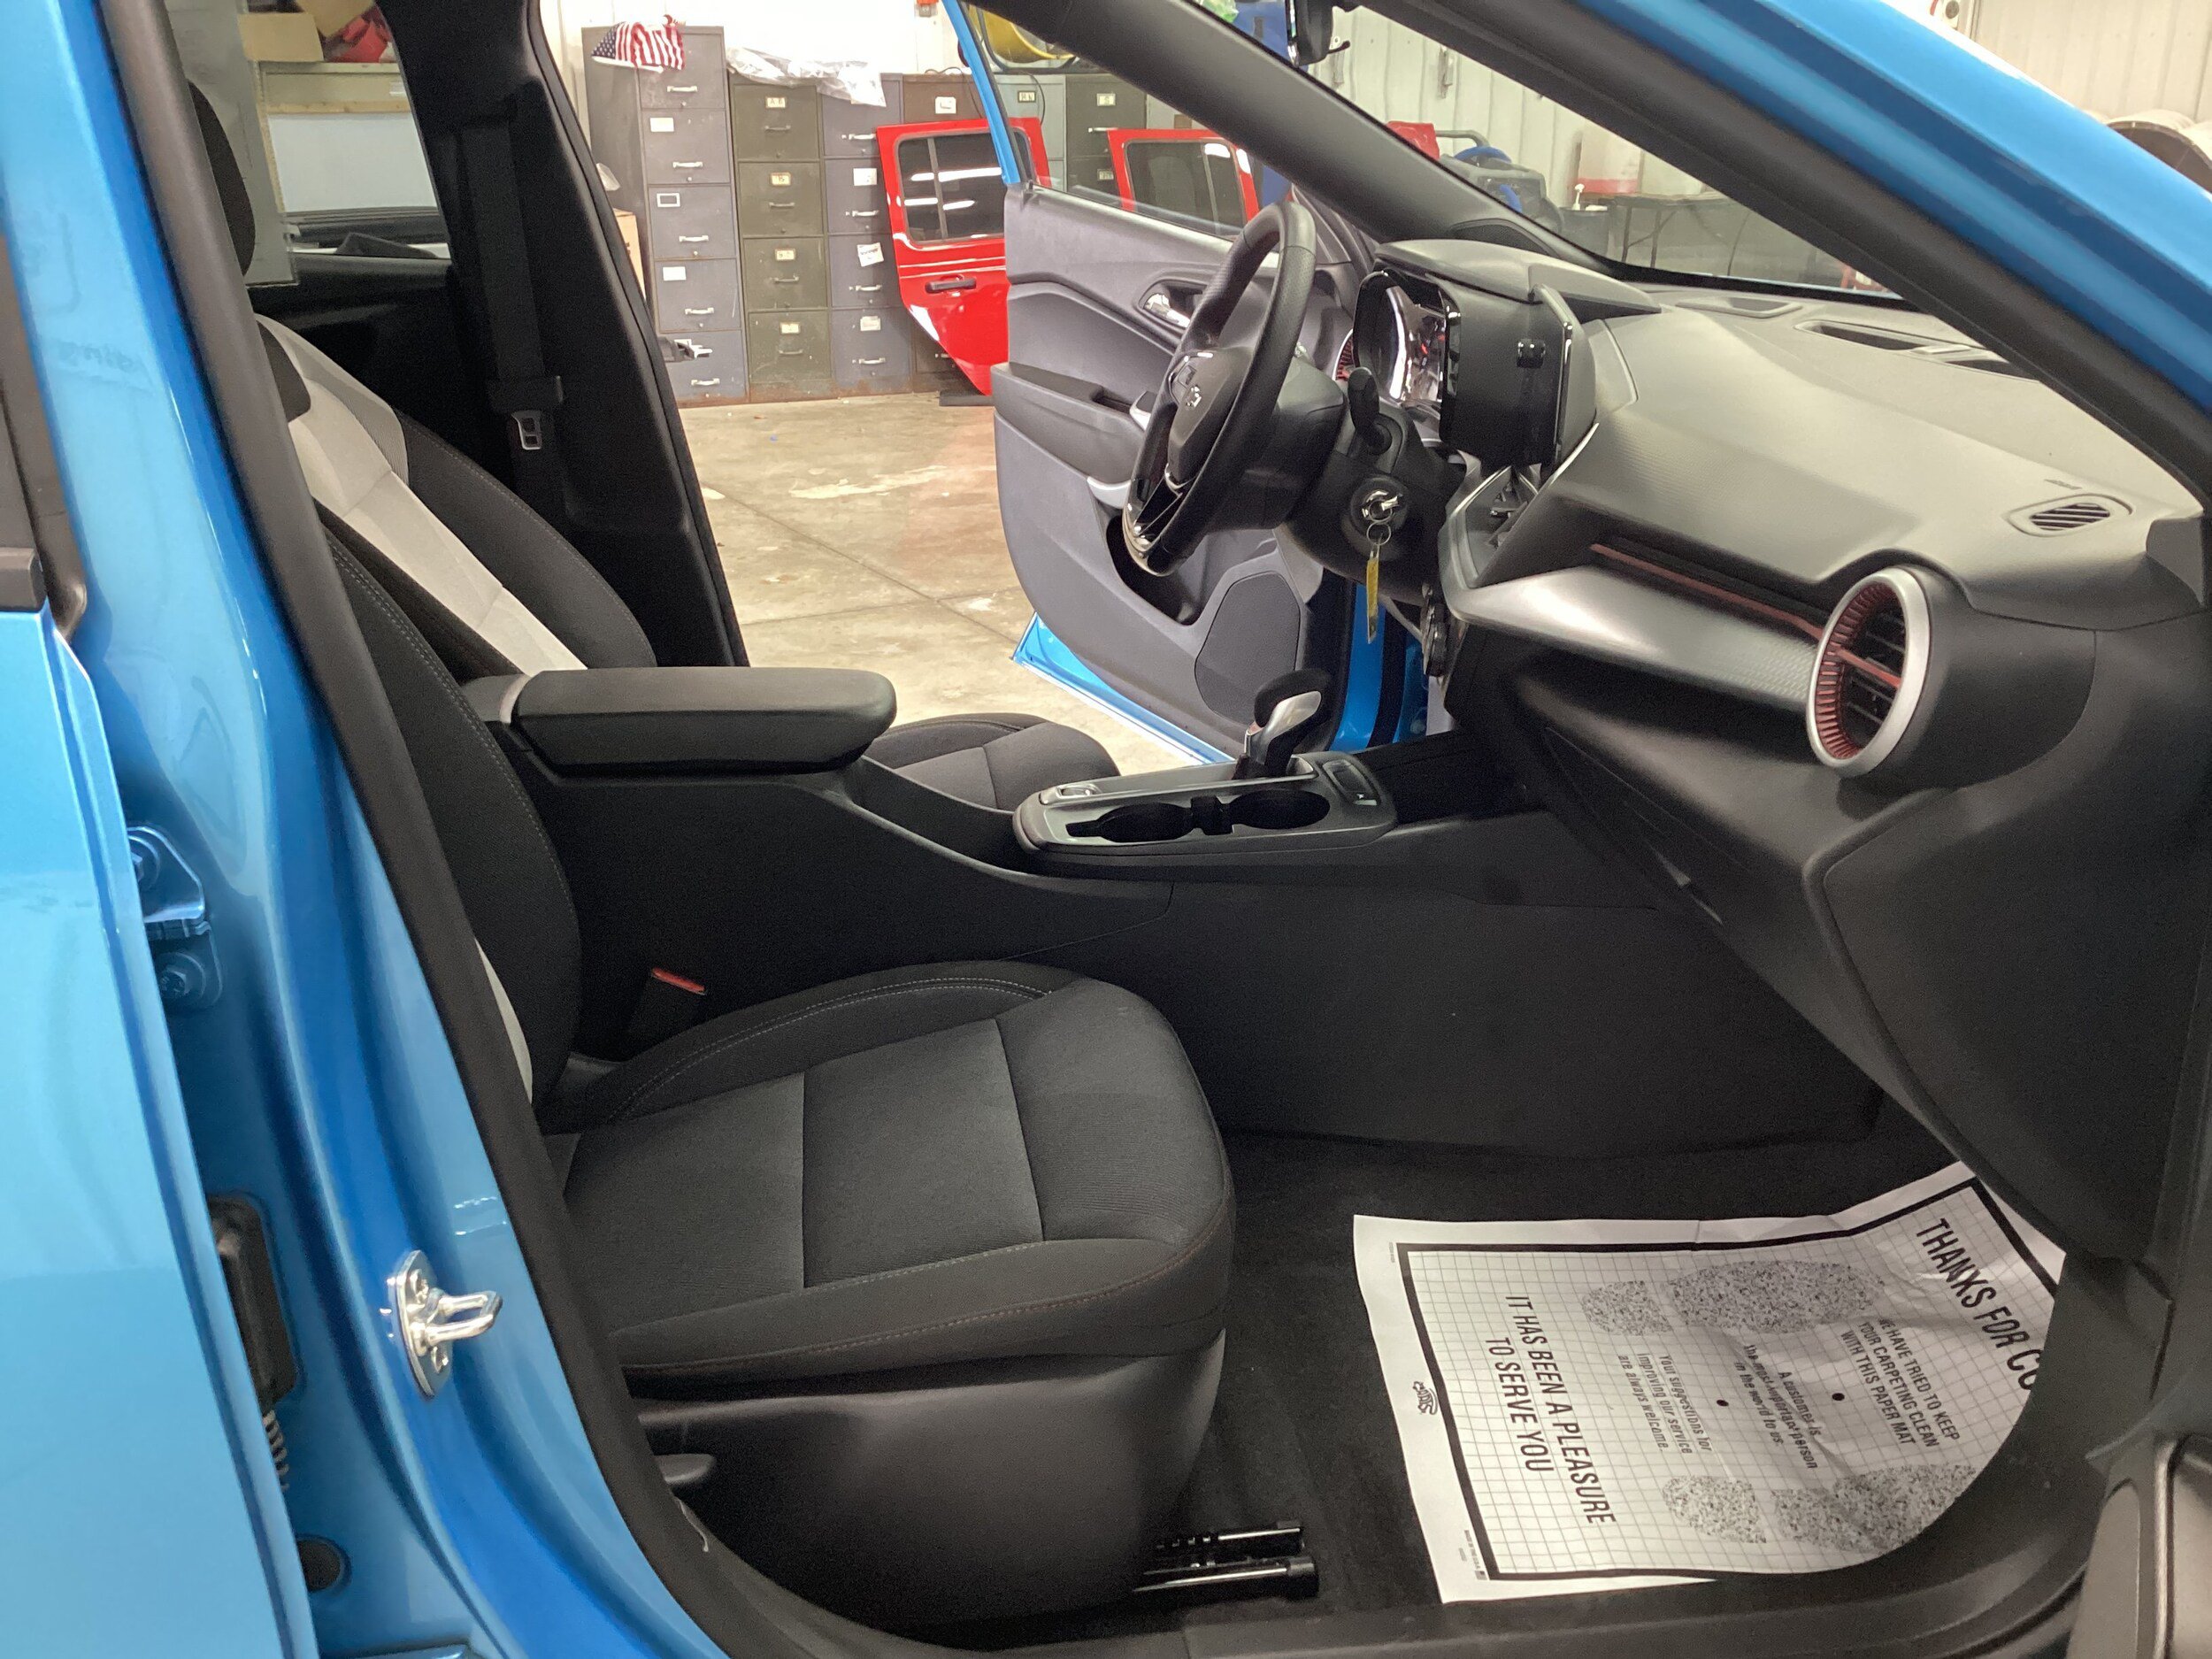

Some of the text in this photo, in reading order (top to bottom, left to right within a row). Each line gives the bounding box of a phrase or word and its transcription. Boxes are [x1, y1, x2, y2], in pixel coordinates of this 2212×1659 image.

[1916, 1217, 1997, 1308] THANKS
[1973, 1306, 2030, 1348] FOR
[1486, 1337, 1555, 1471] TO SERVE YOU
[1505, 1296, 1617, 1524] IT HAS BEEN A PLEASURE
[1618, 1355, 1669, 1452] are always welcome.
[1659, 1355, 1712, 1451] Your suggestions for
[1659, 1400, 1675, 1417] our
[1668, 1417, 1693, 1454] service
[1740, 1374, 1755, 1387] the
[1763, 1418, 1777, 1429] to
[1744, 1345, 1758, 1359] the
[1789, 1432, 1818, 1469] person
[1782, 1381, 1815, 1426] customer
[1808, 1425, 1821, 1436] is
[1840, 1330, 1916, 1444] WITH THIS PAPER MAT
[1858, 1322, 1940, 1448] YOUR CARPETING CLEAN
[1886, 1329, 1913, 1359] HAVE
[1904, 1358, 1932, 1393] TRIED
[1924, 1394, 1942, 1410] TO
[1933, 1410, 1960, 1440] KEEP
